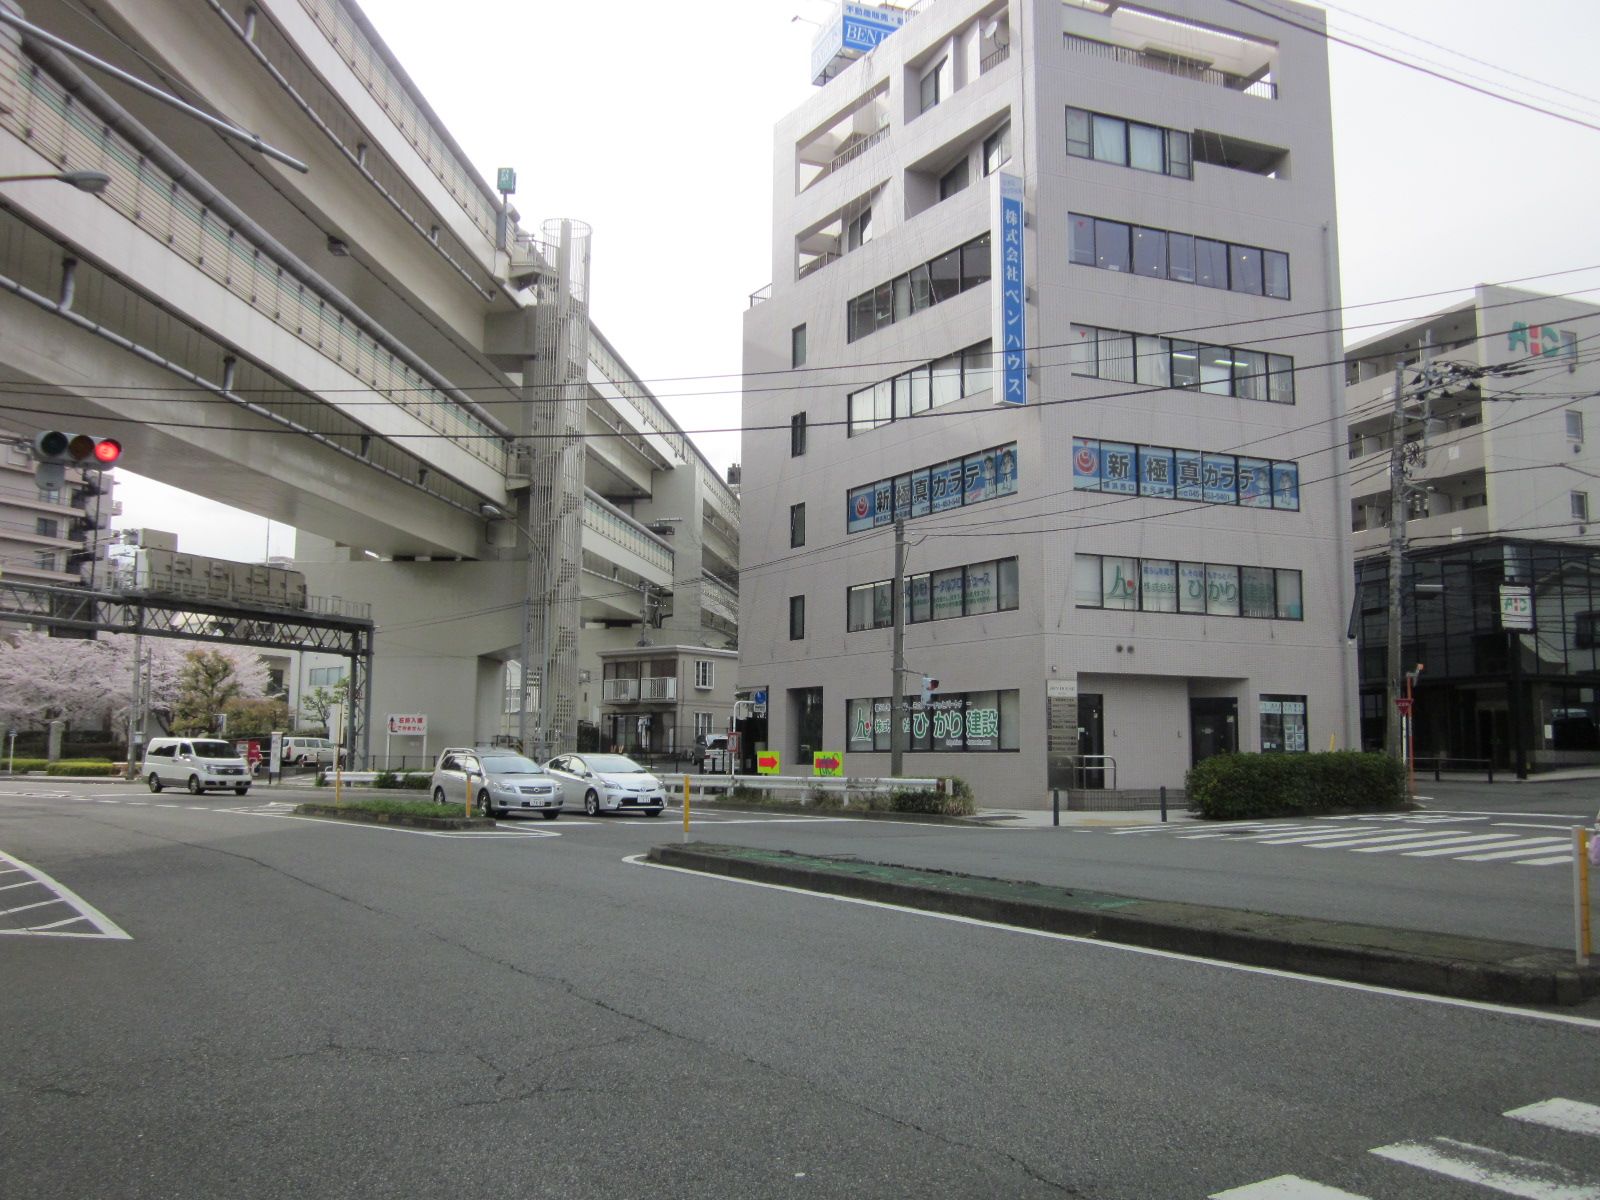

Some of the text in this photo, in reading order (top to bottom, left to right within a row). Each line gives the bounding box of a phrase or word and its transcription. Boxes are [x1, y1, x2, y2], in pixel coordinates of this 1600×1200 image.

[876, 465, 980, 512] 新極真カラテ
[1107, 453, 1255, 490] 新極真カラテ
[913, 708, 998, 738] ひかり建設
